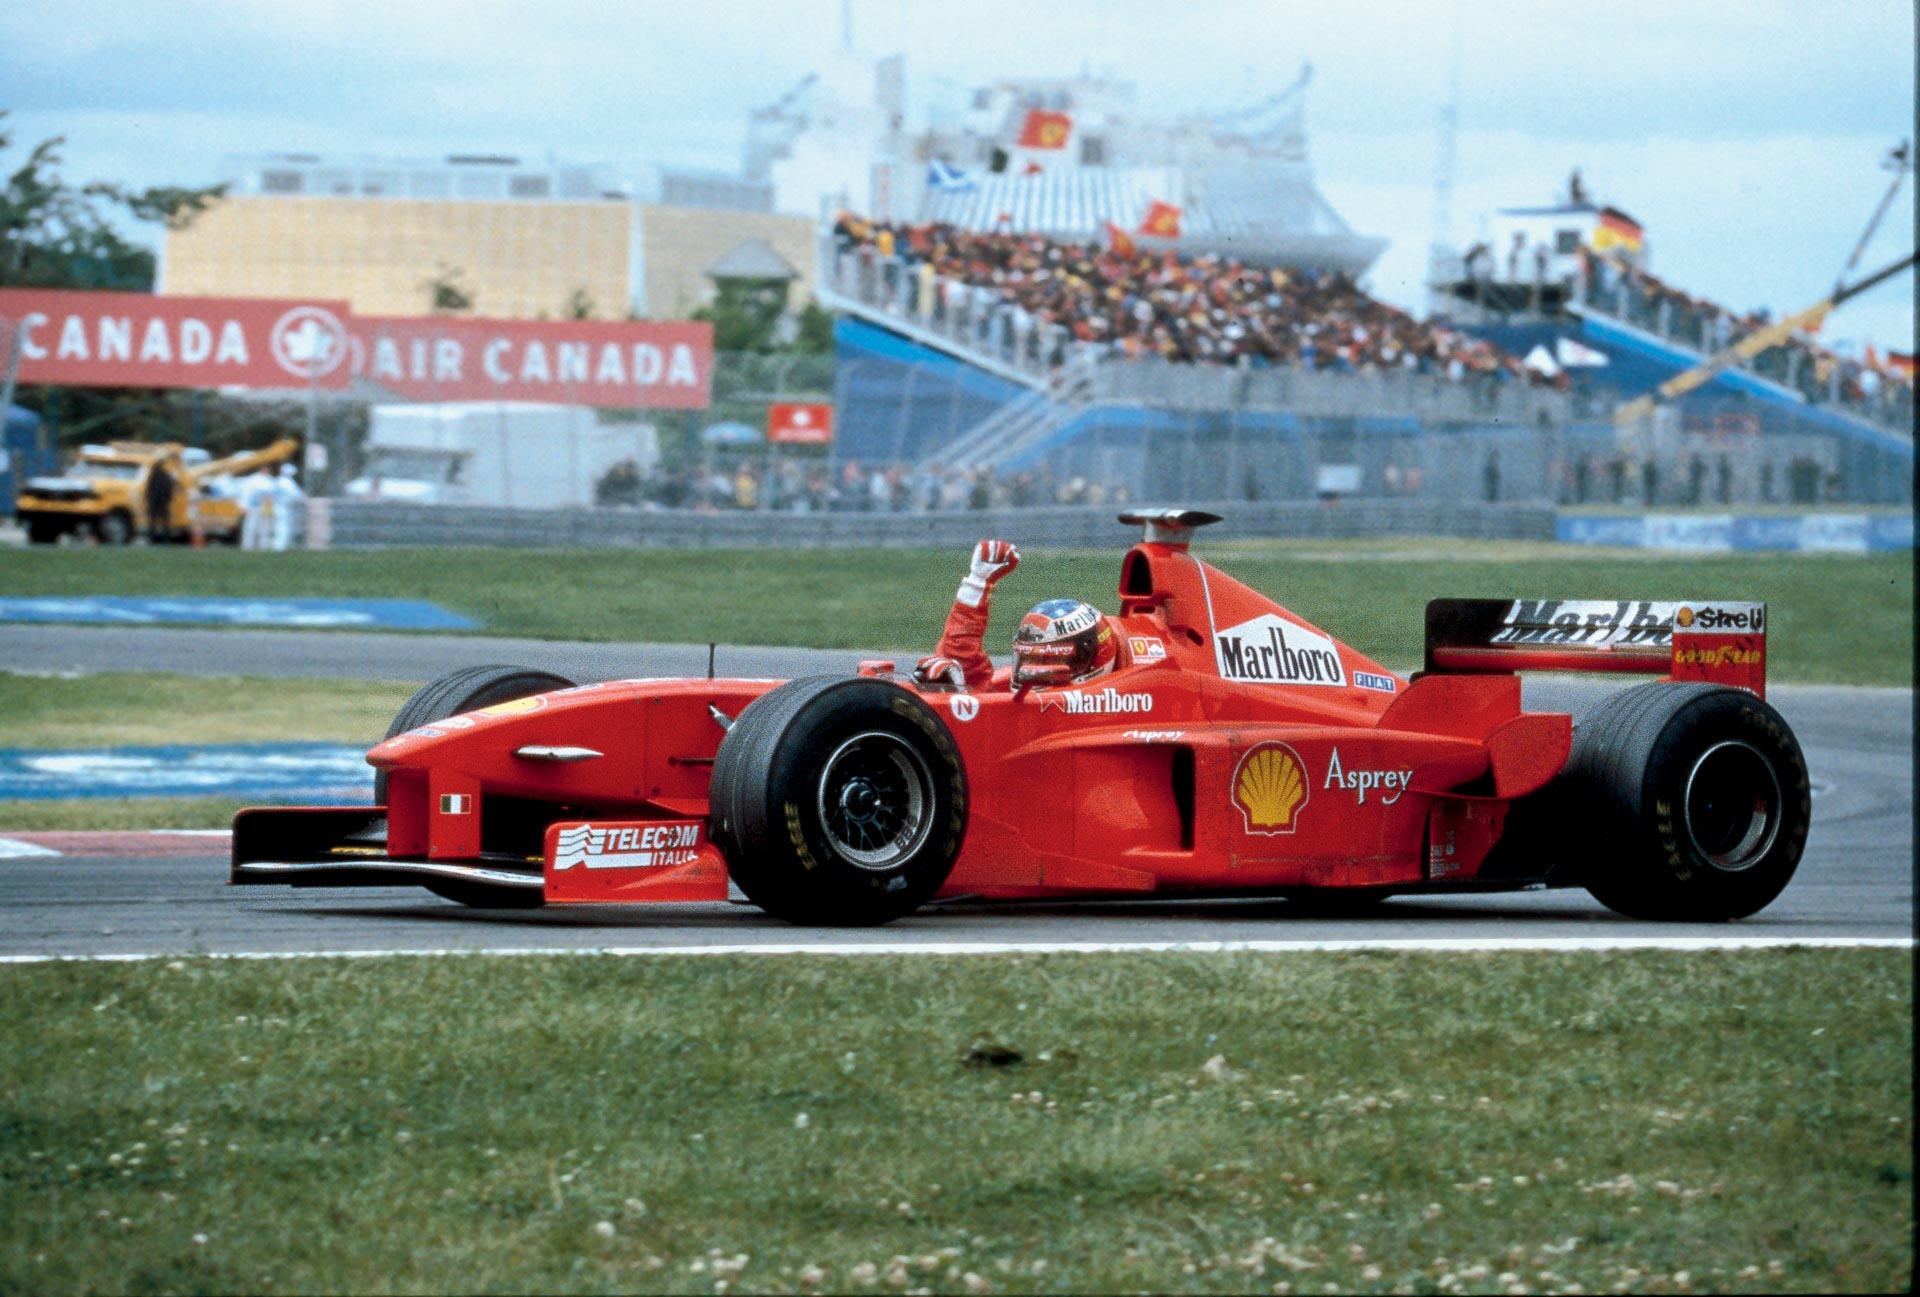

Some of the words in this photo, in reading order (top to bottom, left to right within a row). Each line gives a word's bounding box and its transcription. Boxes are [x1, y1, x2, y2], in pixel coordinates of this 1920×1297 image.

[21, 312, 249, 366] CANADA
[371, 337, 462, 382] AIR
[481, 337, 699, 386] CANADA
[1696, 606, 1762, 629] Shell
[1218, 626, 1341, 683] Marlboro
[1356, 674, 1392, 689] FIAT
[1063, 688, 1153, 713] Marlboro
[1324, 746, 1413, 804] Asprey
[607, 825, 699, 850] TELECOM
